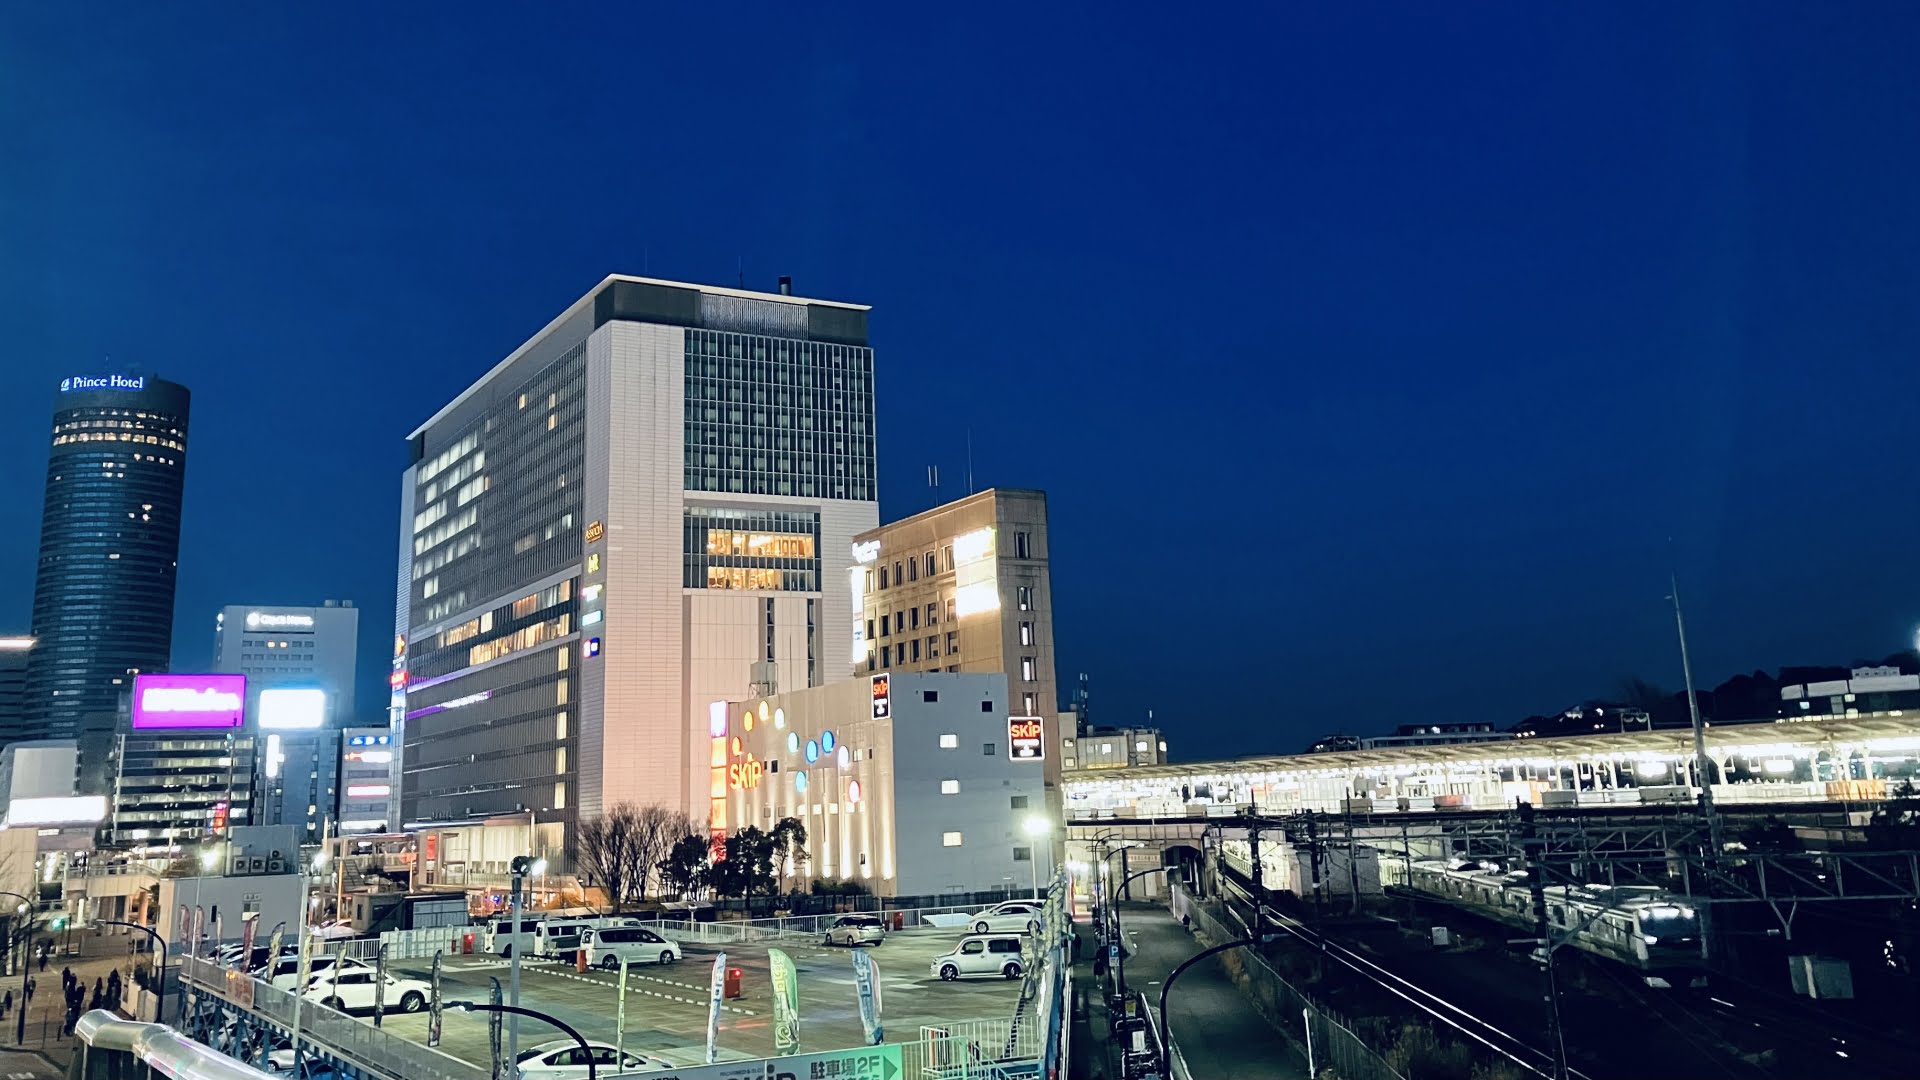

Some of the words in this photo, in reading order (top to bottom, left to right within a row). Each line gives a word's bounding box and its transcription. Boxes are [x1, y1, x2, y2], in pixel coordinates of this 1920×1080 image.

[73, 377, 107, 388] Prince
[111, 375, 143, 388] Hotel
[810, 1055, 880, 1079] 駐車場2F
